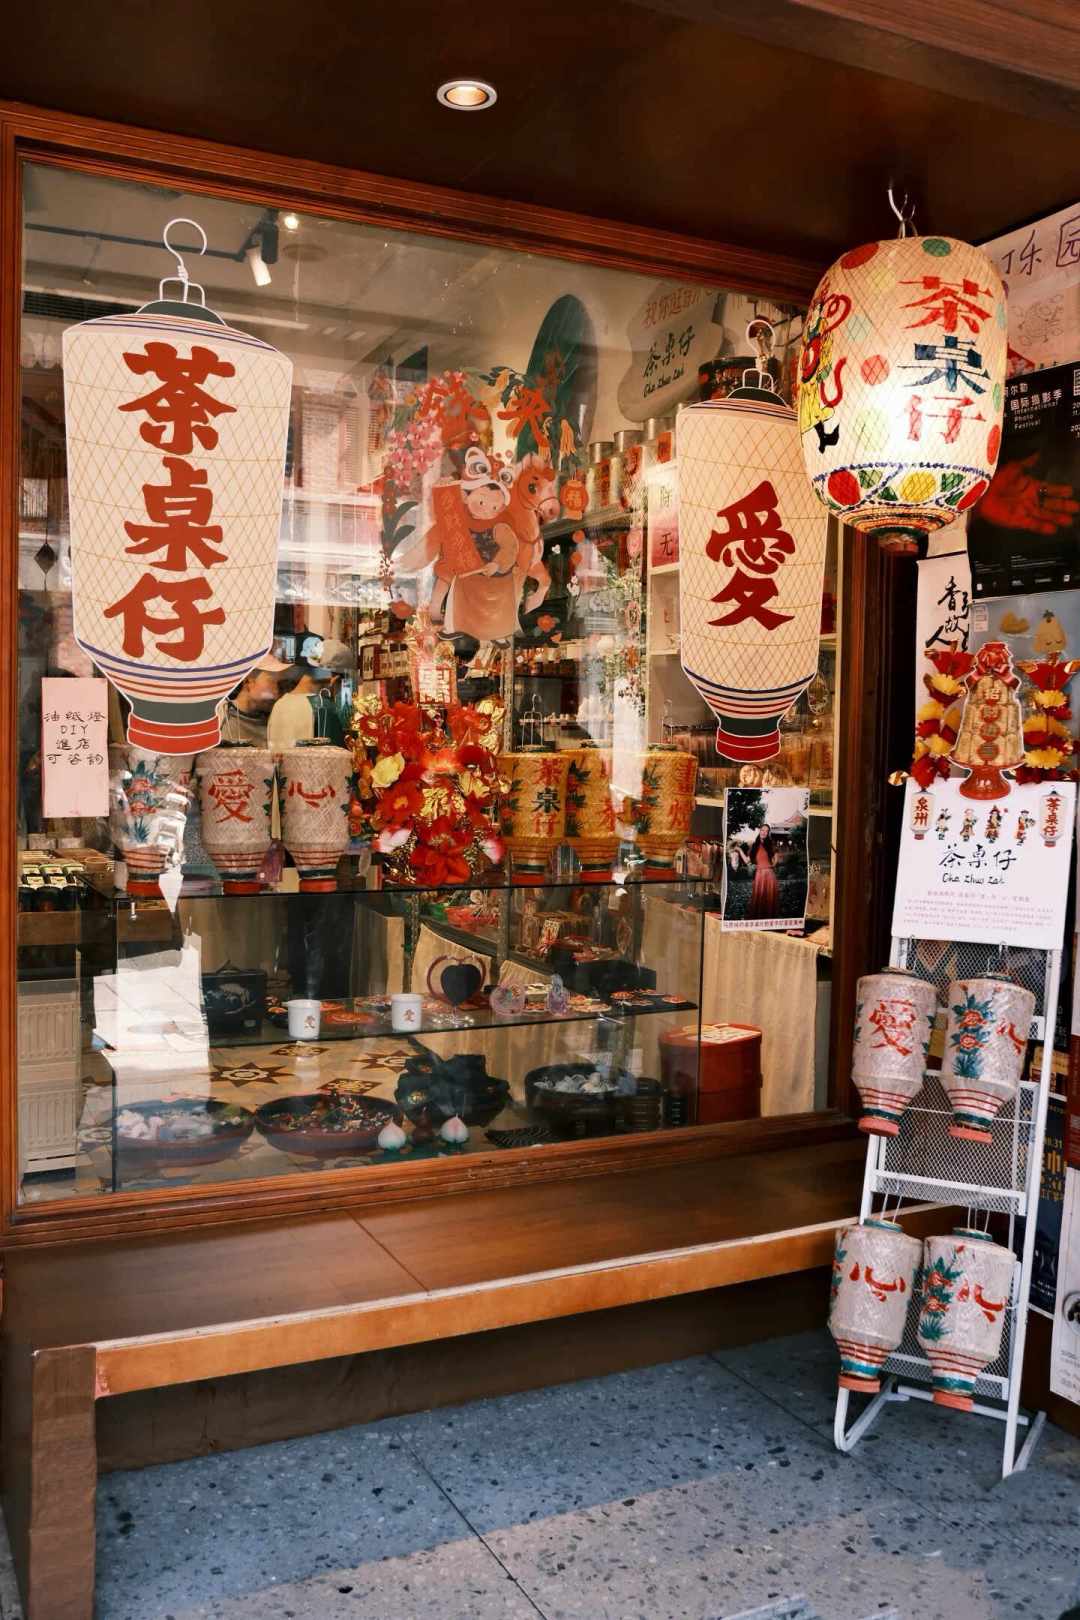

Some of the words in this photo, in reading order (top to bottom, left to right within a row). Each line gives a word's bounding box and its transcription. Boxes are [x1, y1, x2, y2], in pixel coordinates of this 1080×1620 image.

[897, 275, 994, 444] 茶桌仔
[103, 341, 237, 661] 茶桌仔
[60, 724, 89, 736] DIY
[208, 769, 255, 824] 愛
[288, 780, 336, 809] 心
[914, 797, 929, 827] 泉州
[1043, 797, 1061, 837] 茶桌仔
[938, 843, 1017, 871] 茶桌仔
[869, 999, 917, 1057] 愛
[849, 1261, 906, 1302] 心
